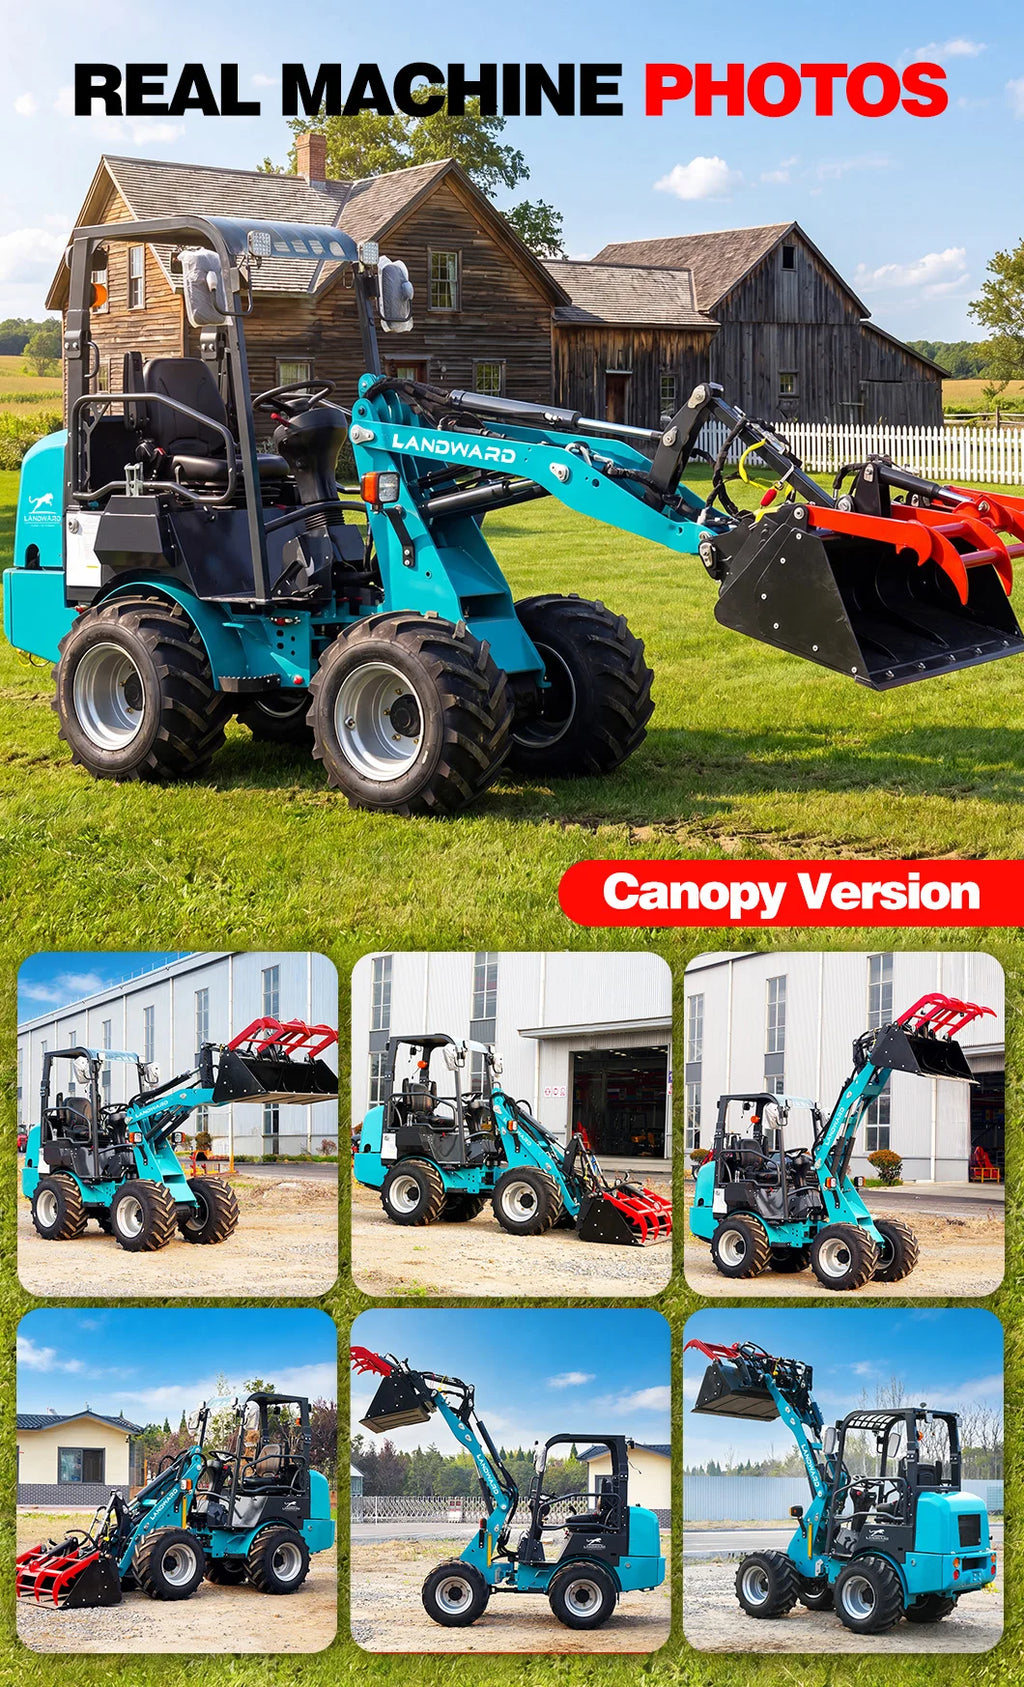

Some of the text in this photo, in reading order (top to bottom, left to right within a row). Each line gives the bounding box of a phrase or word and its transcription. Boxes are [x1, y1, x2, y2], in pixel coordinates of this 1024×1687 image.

[392, 433, 516, 464] LANDWARD
[476, 1453, 499, 1495] LANDWARD
[801, 1443, 820, 1488] LANDWARD
[149, 1488, 178, 1520] LANDWARD
